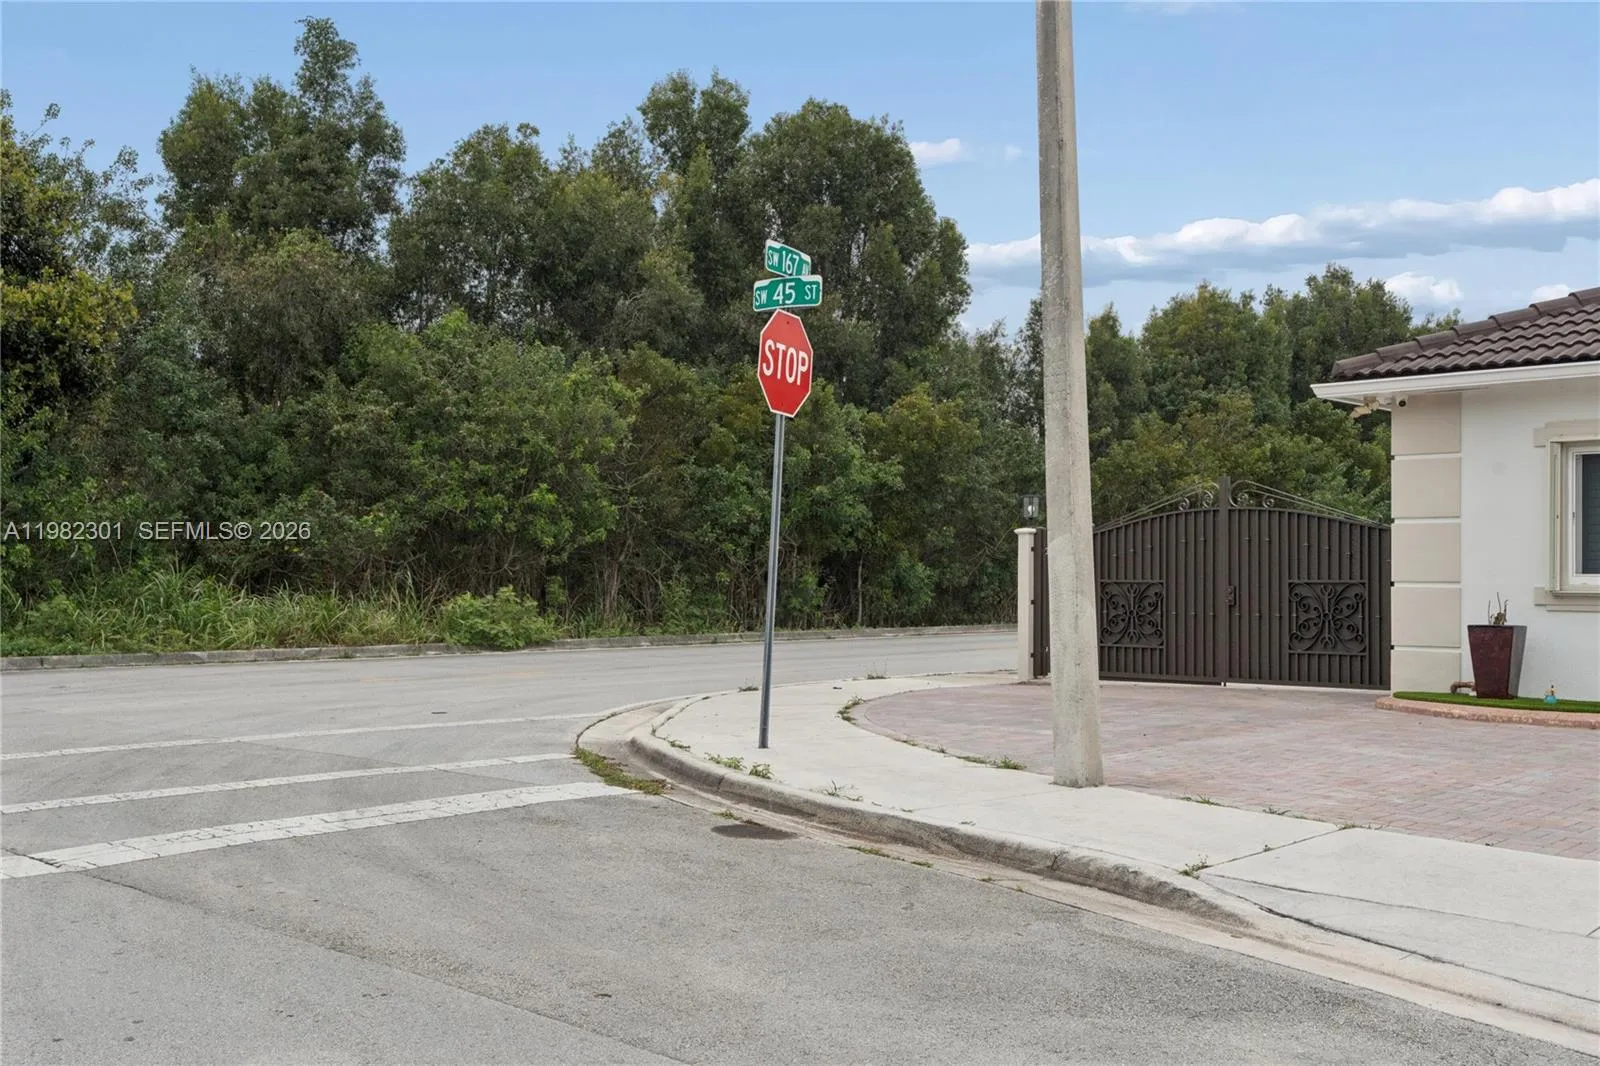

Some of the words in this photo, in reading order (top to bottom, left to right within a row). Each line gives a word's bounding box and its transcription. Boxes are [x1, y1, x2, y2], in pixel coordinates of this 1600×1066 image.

[768, 250, 780, 267] SW
[782, 251, 799, 276] 167
[755, 289, 768, 306] SW
[773, 282, 796, 304] 45
[804, 284, 817, 300] ST
[762, 339, 809, 386] STOP
